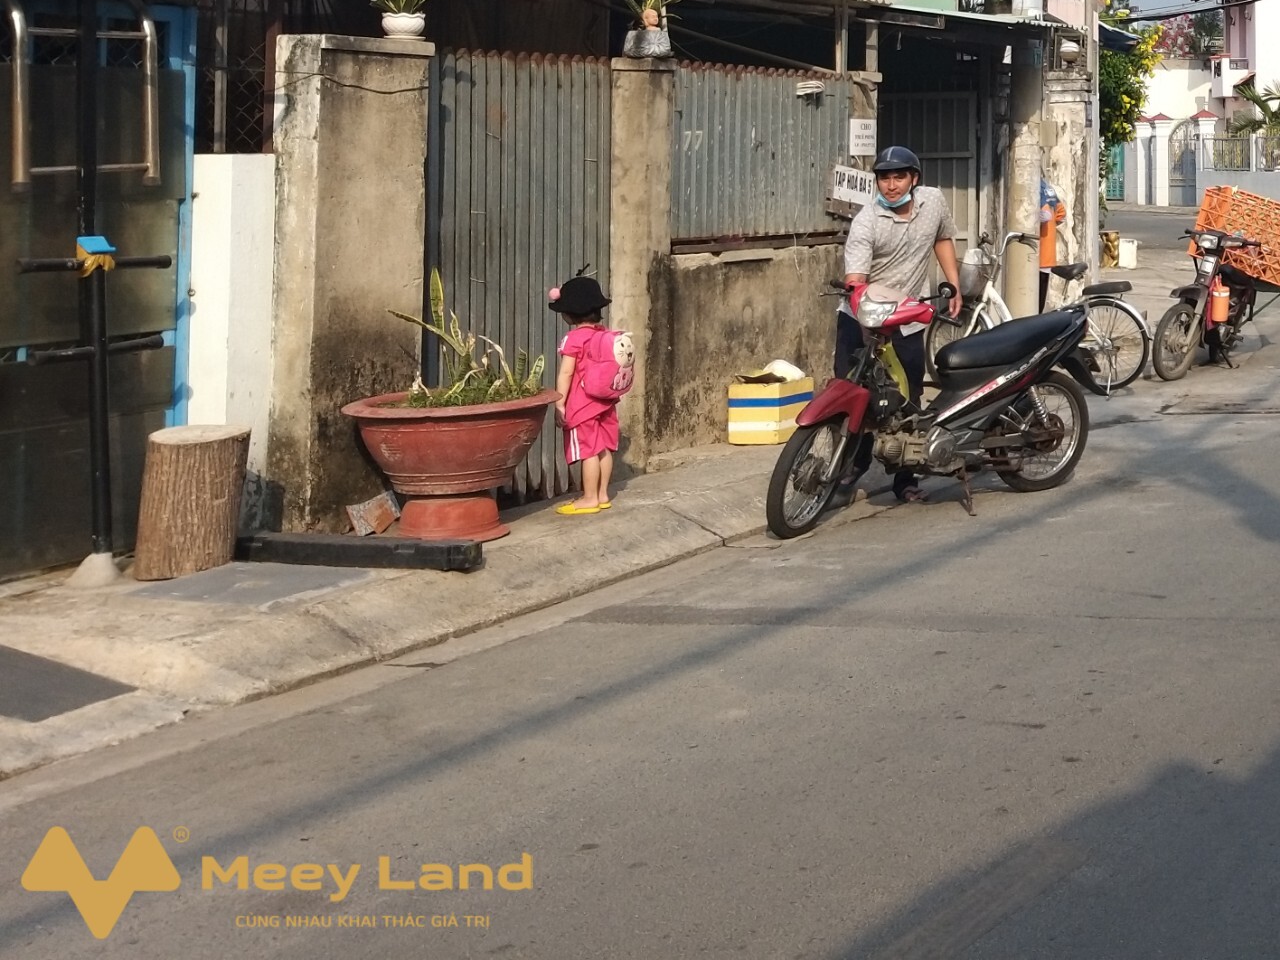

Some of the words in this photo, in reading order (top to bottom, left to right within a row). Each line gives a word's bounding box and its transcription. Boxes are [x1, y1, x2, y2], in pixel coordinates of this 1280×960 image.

[860, 123, 871, 131] CHO
[683, 130, 703, 151] 77
[868, 179, 873, 195] 5
